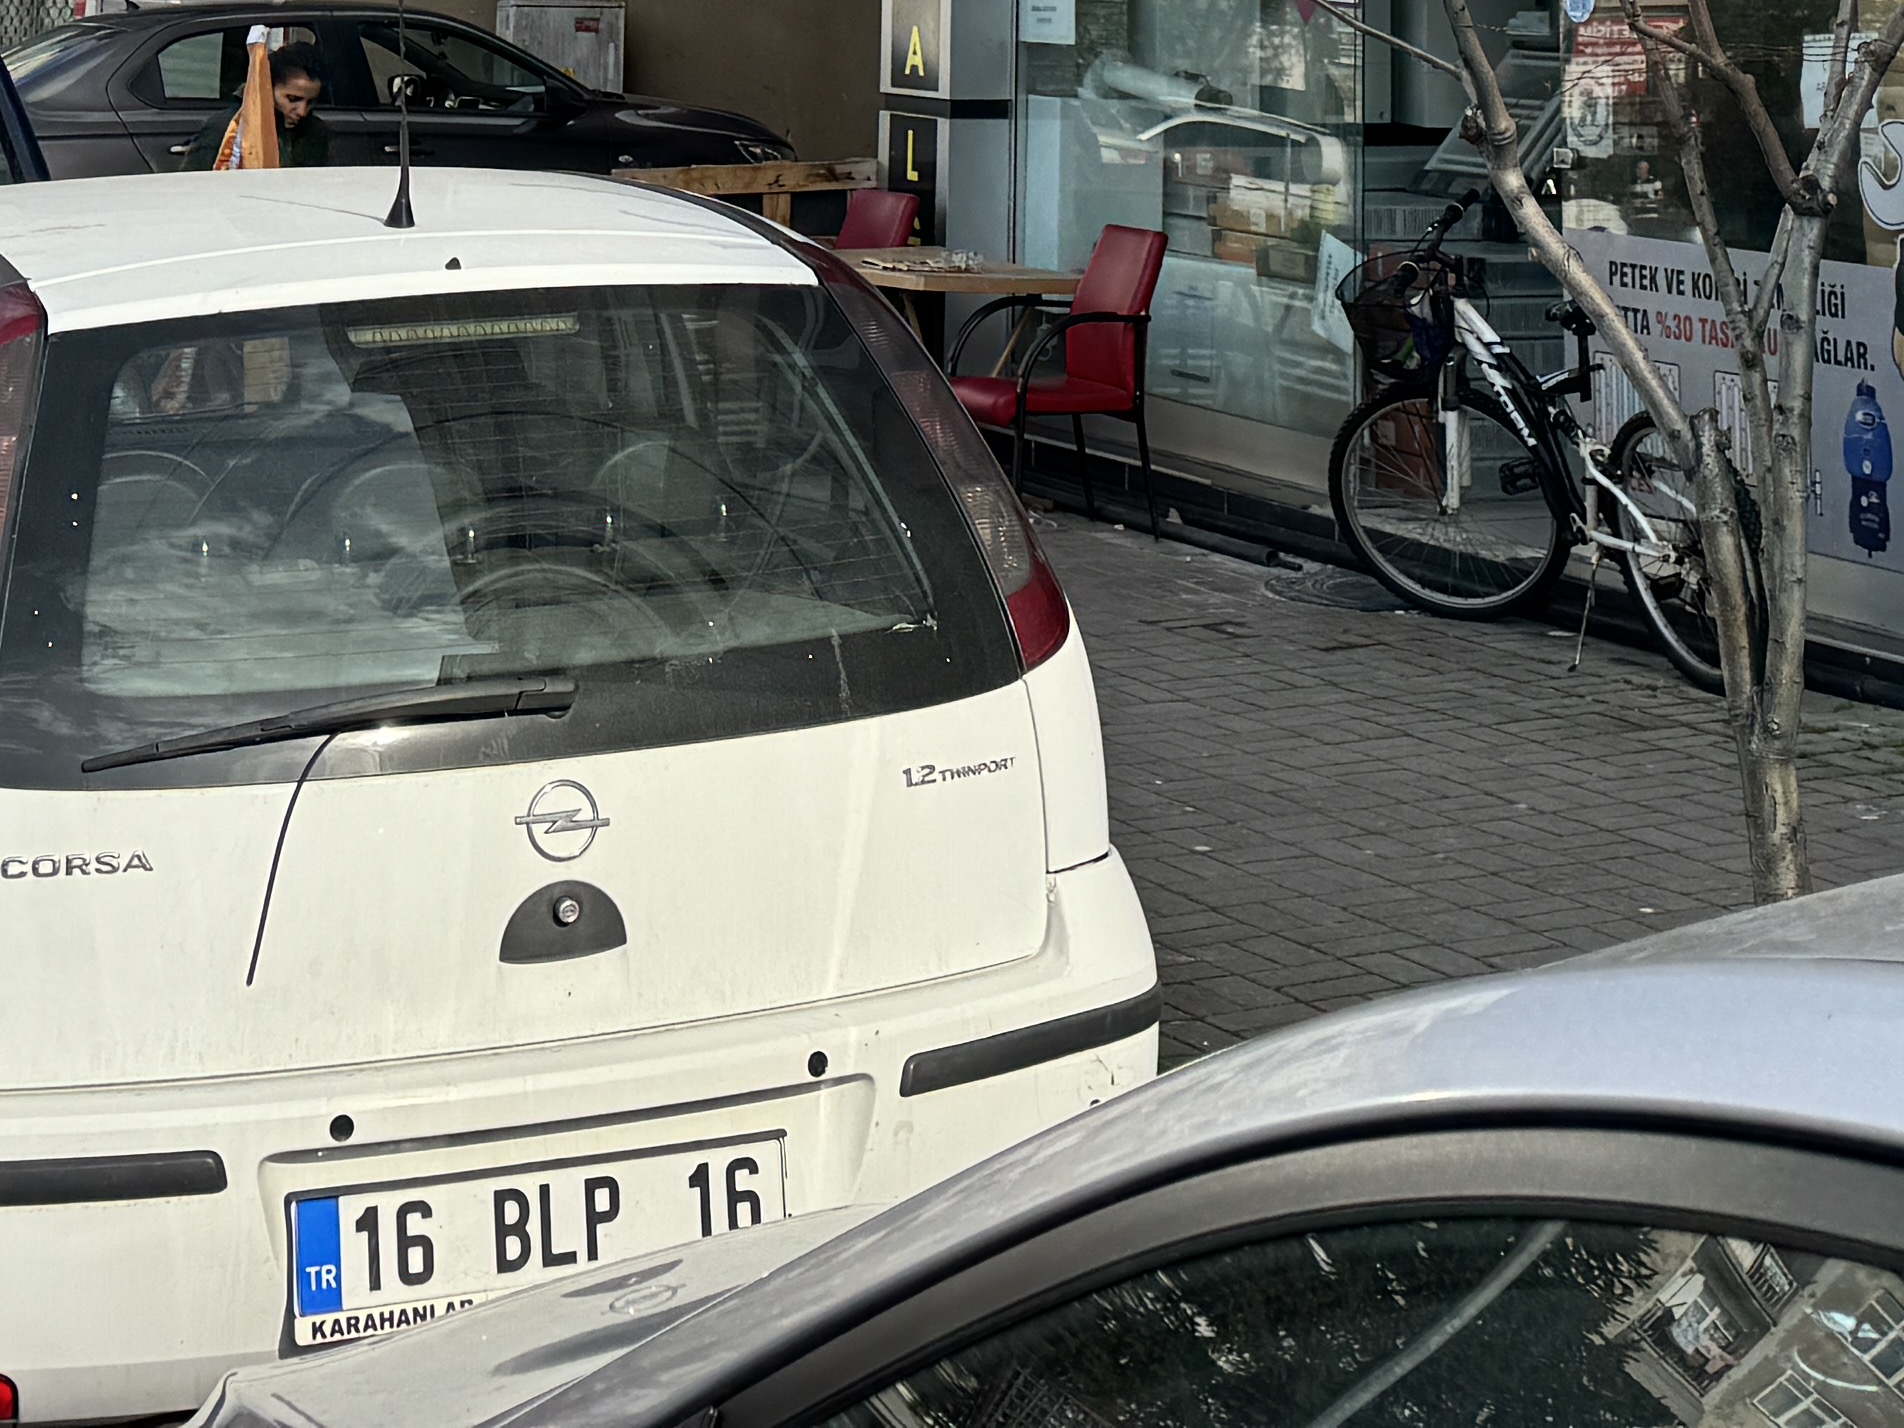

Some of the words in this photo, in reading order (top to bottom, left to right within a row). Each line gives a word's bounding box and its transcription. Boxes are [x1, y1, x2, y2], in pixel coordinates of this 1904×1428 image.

[1609, 260, 1659, 293] PETEK
[1664, 268, 1686, 296] VE
[1655, 311, 1694, 344] %30
[938, 756, 1016, 782] TWINPORT
[0, 849, 154, 879] CORSA
[355, 1200, 436, 1293] 16
[494, 1176, 621, 1274] BLP
[687, 1156, 763, 1239] 16
[305, 1263, 338, 1292] TR
